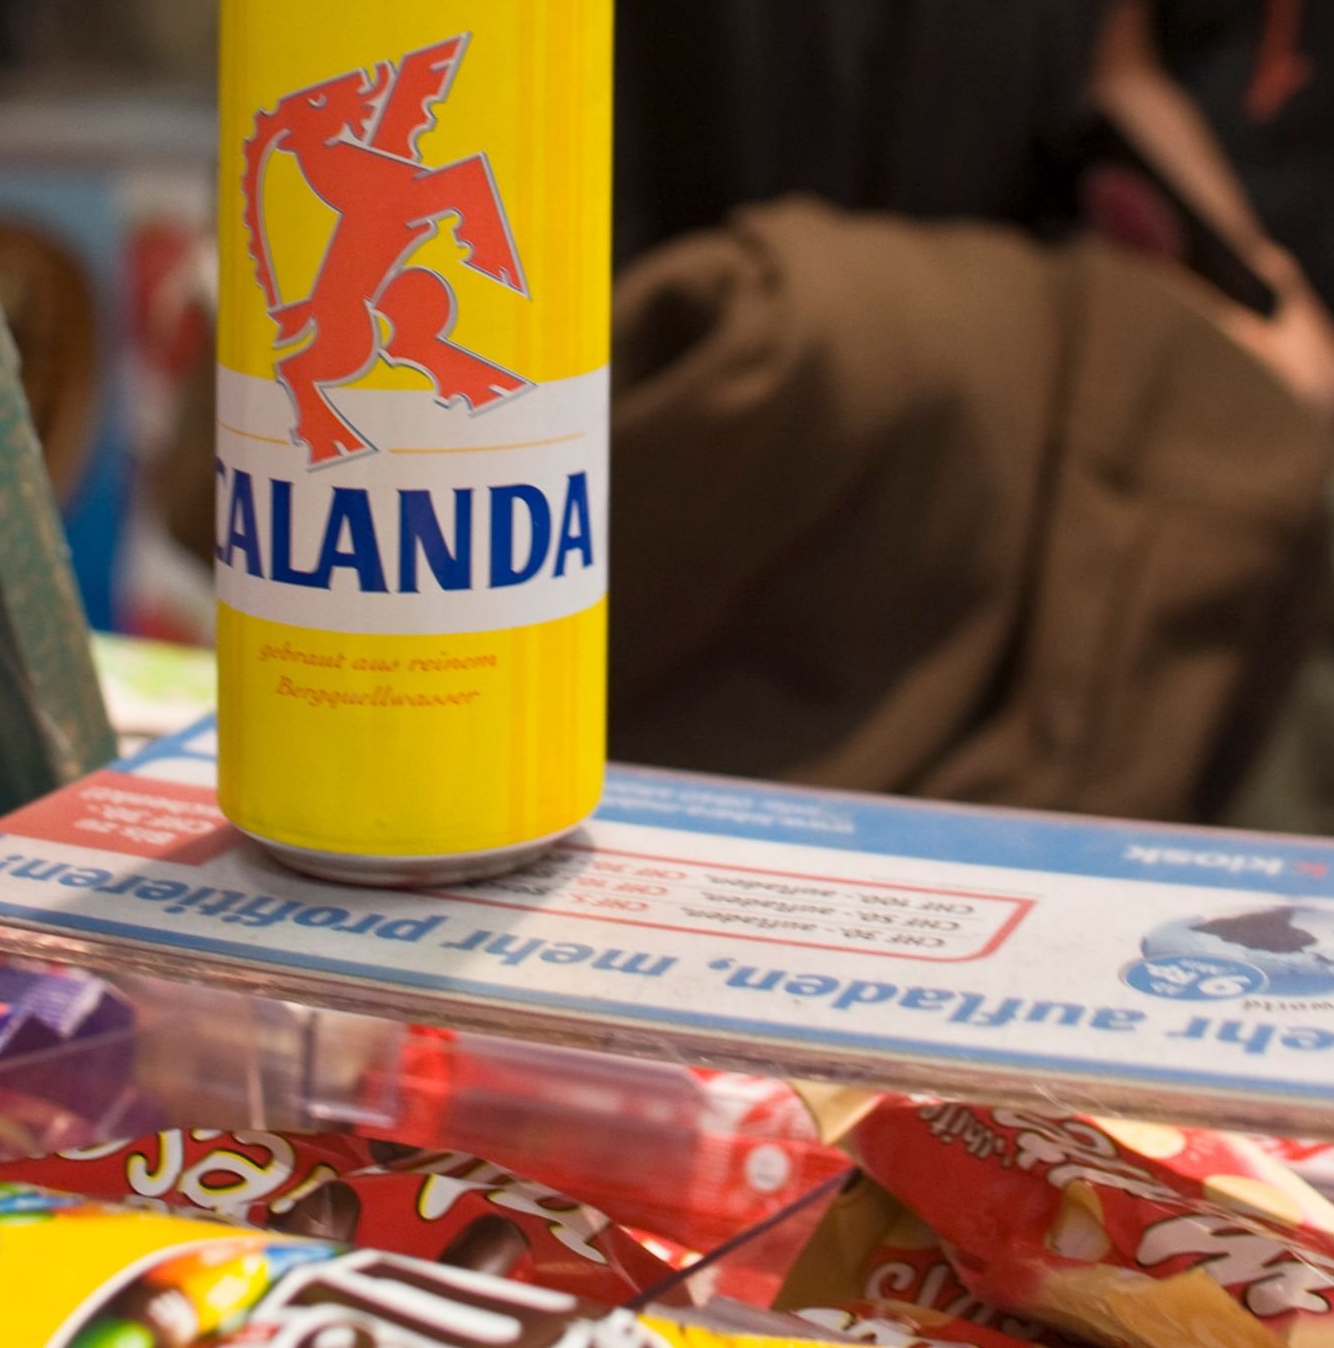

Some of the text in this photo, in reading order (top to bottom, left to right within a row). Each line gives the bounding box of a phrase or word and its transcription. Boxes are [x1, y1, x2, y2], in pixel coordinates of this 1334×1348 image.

[258, 640, 499, 674] gebraut aus reinem
[275, 675, 480, 710] Bergquellwasser
[680, 906, 818, 934] aufladen,
[700, 891, 836, 918] aufladen,
[445, 928, 677, 979] mehr
[886, 933, 947, 950] CHF
[706, 956, 1148, 1033] aufladen,
